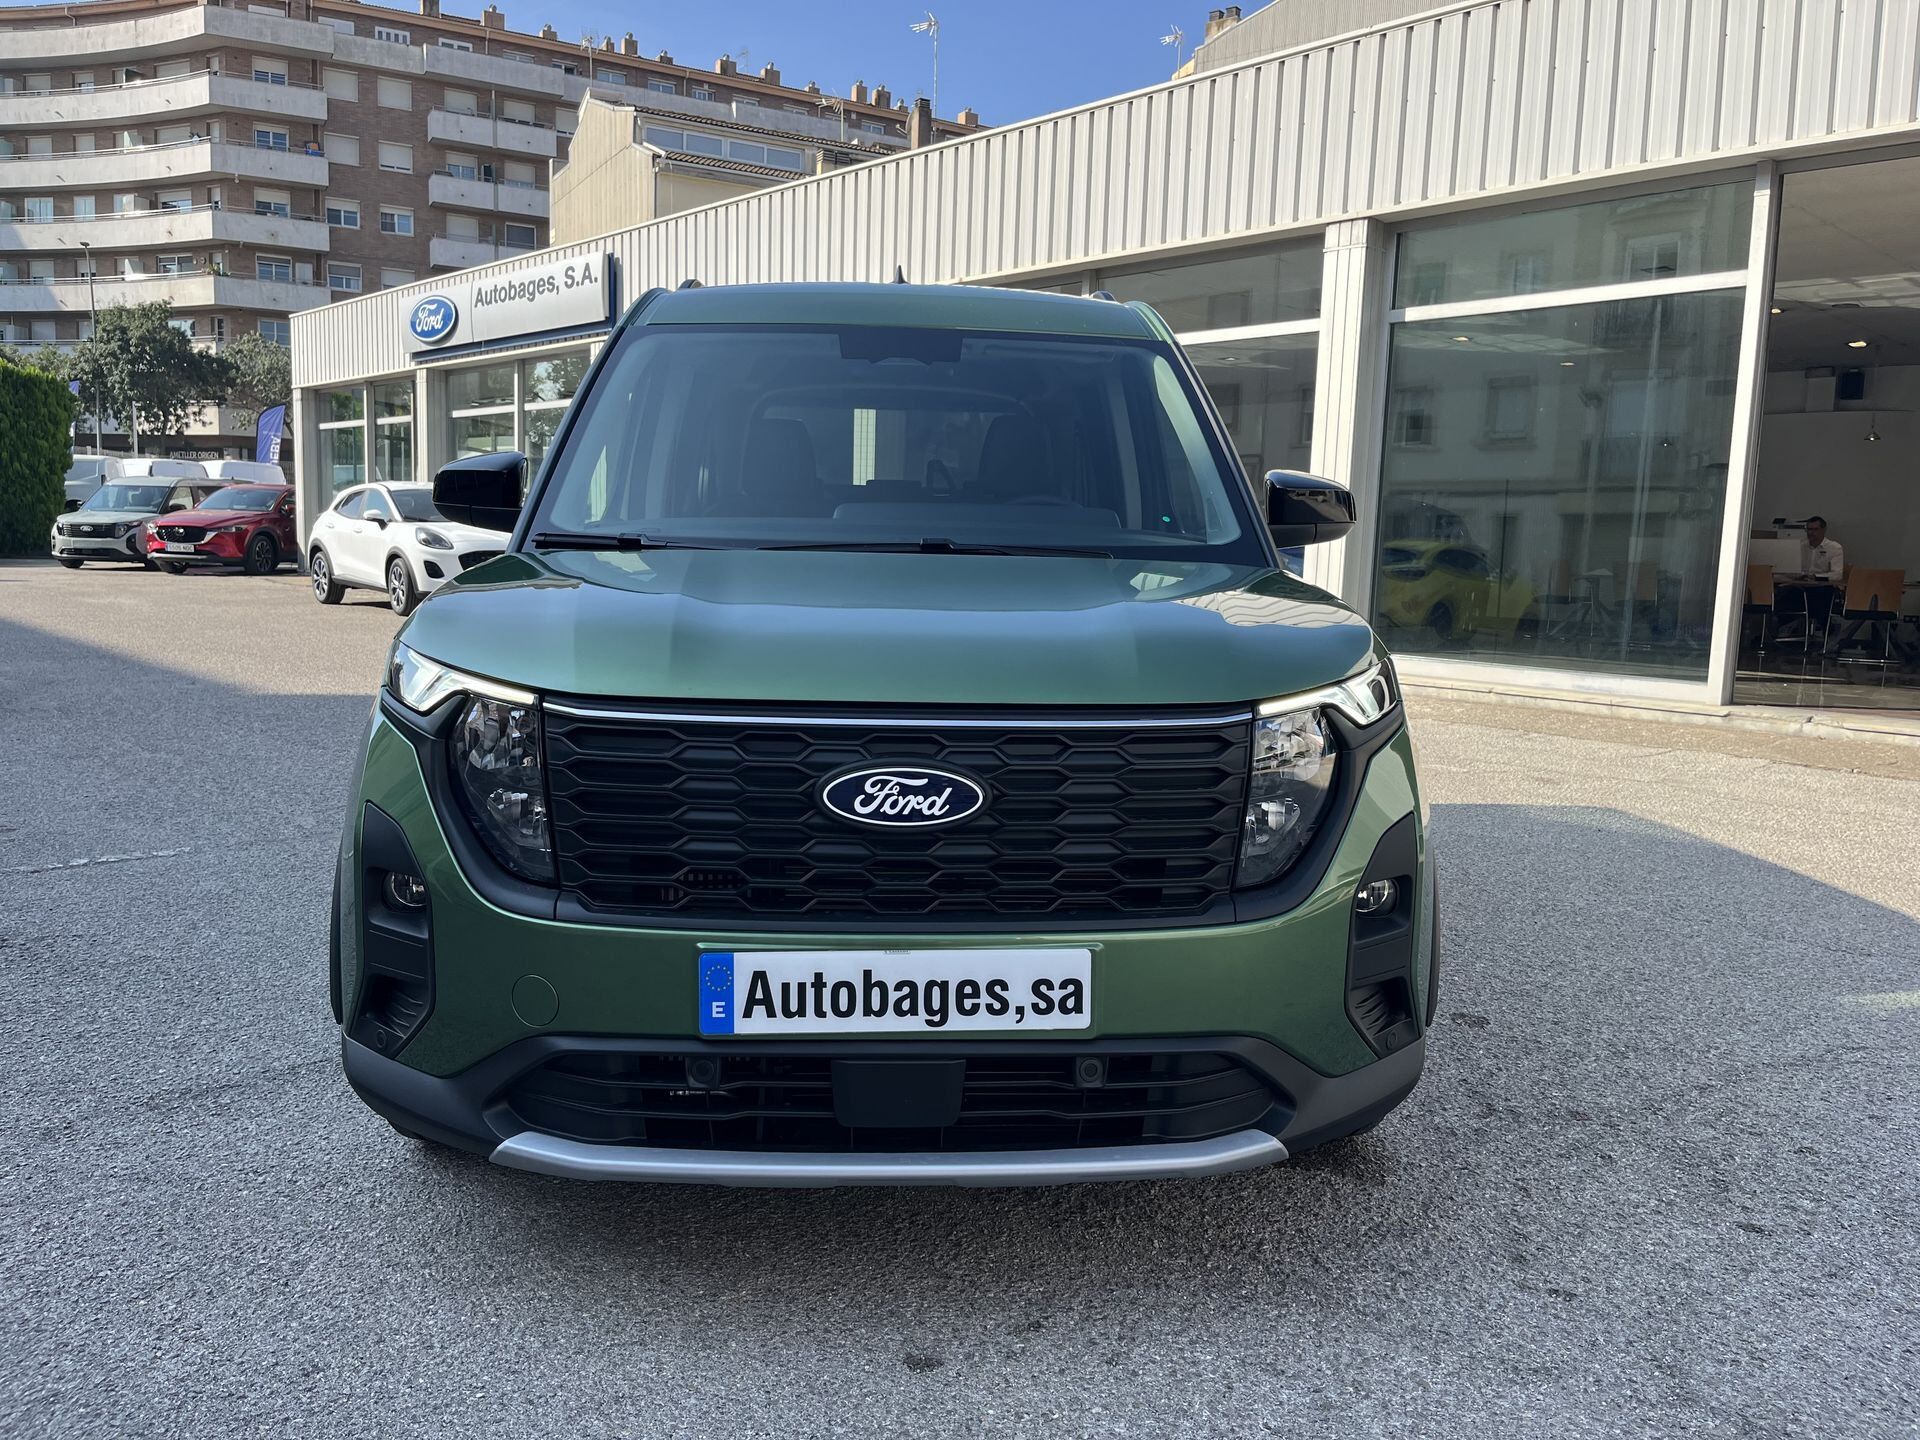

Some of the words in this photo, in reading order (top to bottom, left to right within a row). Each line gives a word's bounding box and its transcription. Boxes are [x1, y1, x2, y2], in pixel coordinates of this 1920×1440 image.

[474, 275, 560, 308] Autobages,
[564, 262, 598, 289] S.A.
[415, 303, 445, 333] Ford
[853, 775, 953, 816] Ford
[711, 1001, 726, 1018] E
[742, 969, 1084, 1028] Autobages,sa
